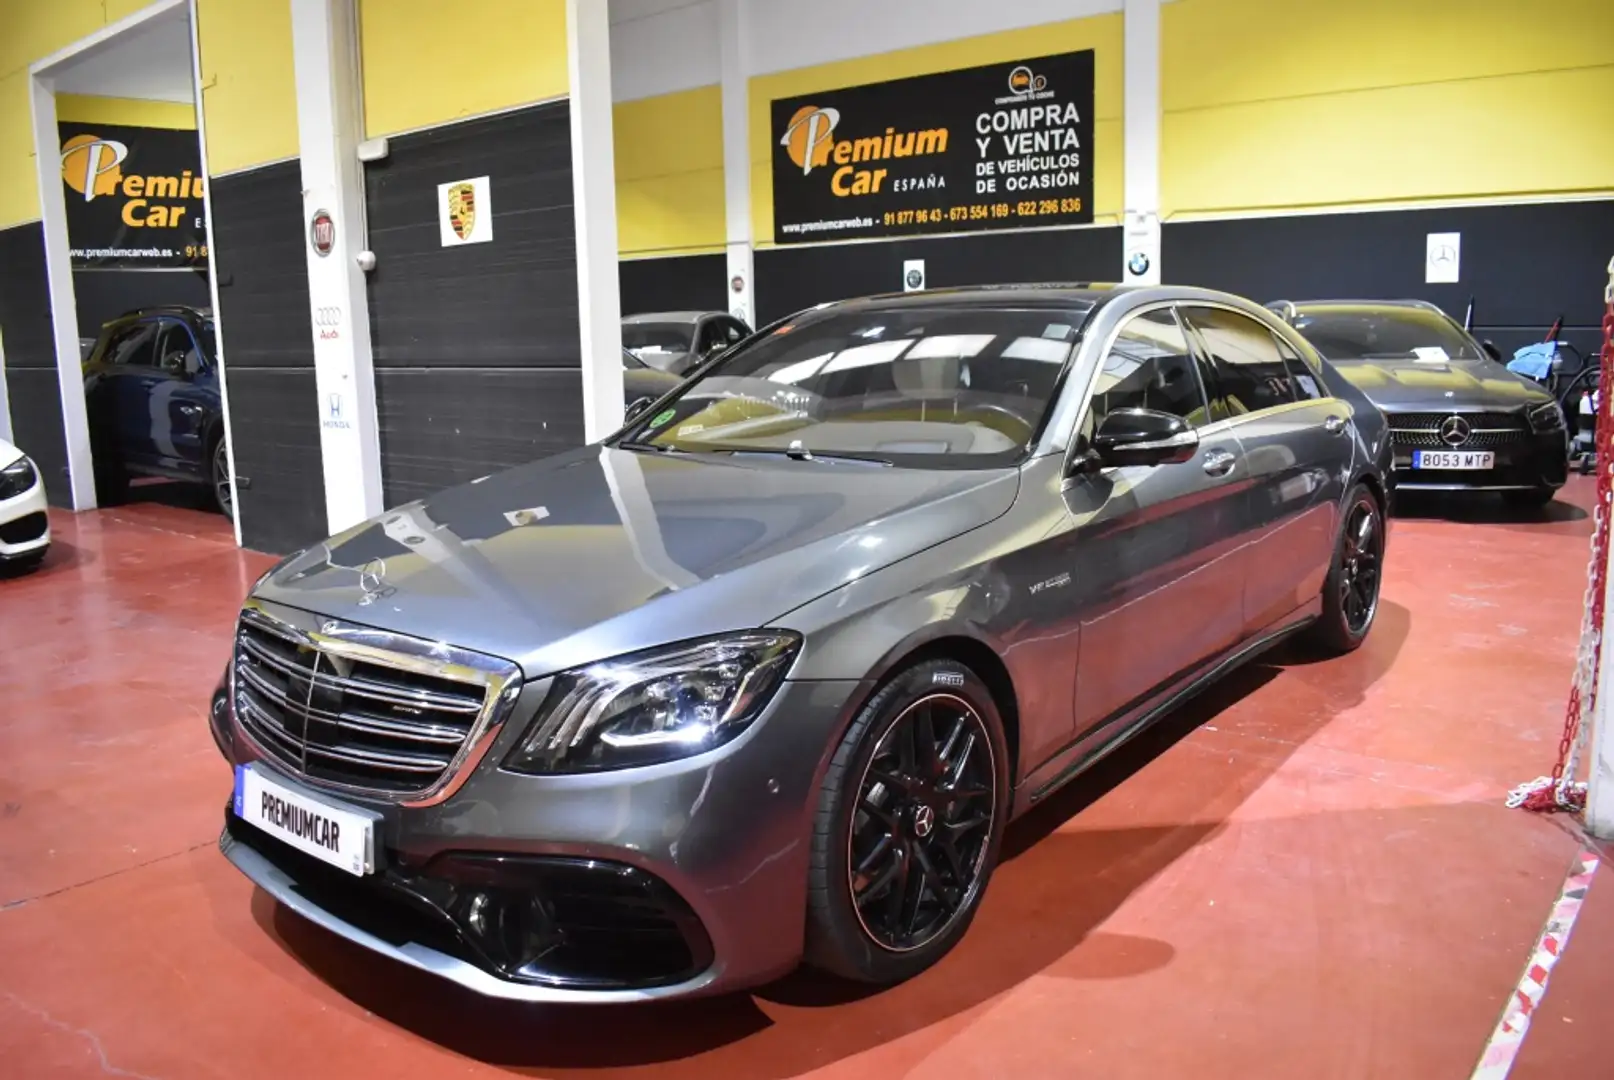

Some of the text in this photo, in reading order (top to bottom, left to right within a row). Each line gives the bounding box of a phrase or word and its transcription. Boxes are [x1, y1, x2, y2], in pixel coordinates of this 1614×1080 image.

[976, 102, 1080, 134] COMPRA
[780, 107, 948, 176] Premium
[976, 127, 1080, 158] Y VENTA
[976, 153, 1080, 176] DE VEHÍCULOS
[831, 166, 946, 197] Car ESPAÑA
[976, 169, 1080, 194] DE OCASIÓN
[121, 199, 186, 228] Car
[782, 216, 873, 234] www.premiumcarweb.es
[884, 212, 895, 225] 91
[897, 210, 914, 225] 877
[916, 209, 928, 223] 96
[930, 208, 941, 222] 43
[950, 206, 967, 221] 673
[970, 204, 988, 219] 554
[1017, 200, 1037, 216] 622
[1061, 198, 1081, 213] 836
[185, 245, 197, 257] 91
[1423, 454, 1491, 467] 8053 MTP
[261, 790, 340, 853] PREMIUMCAR
